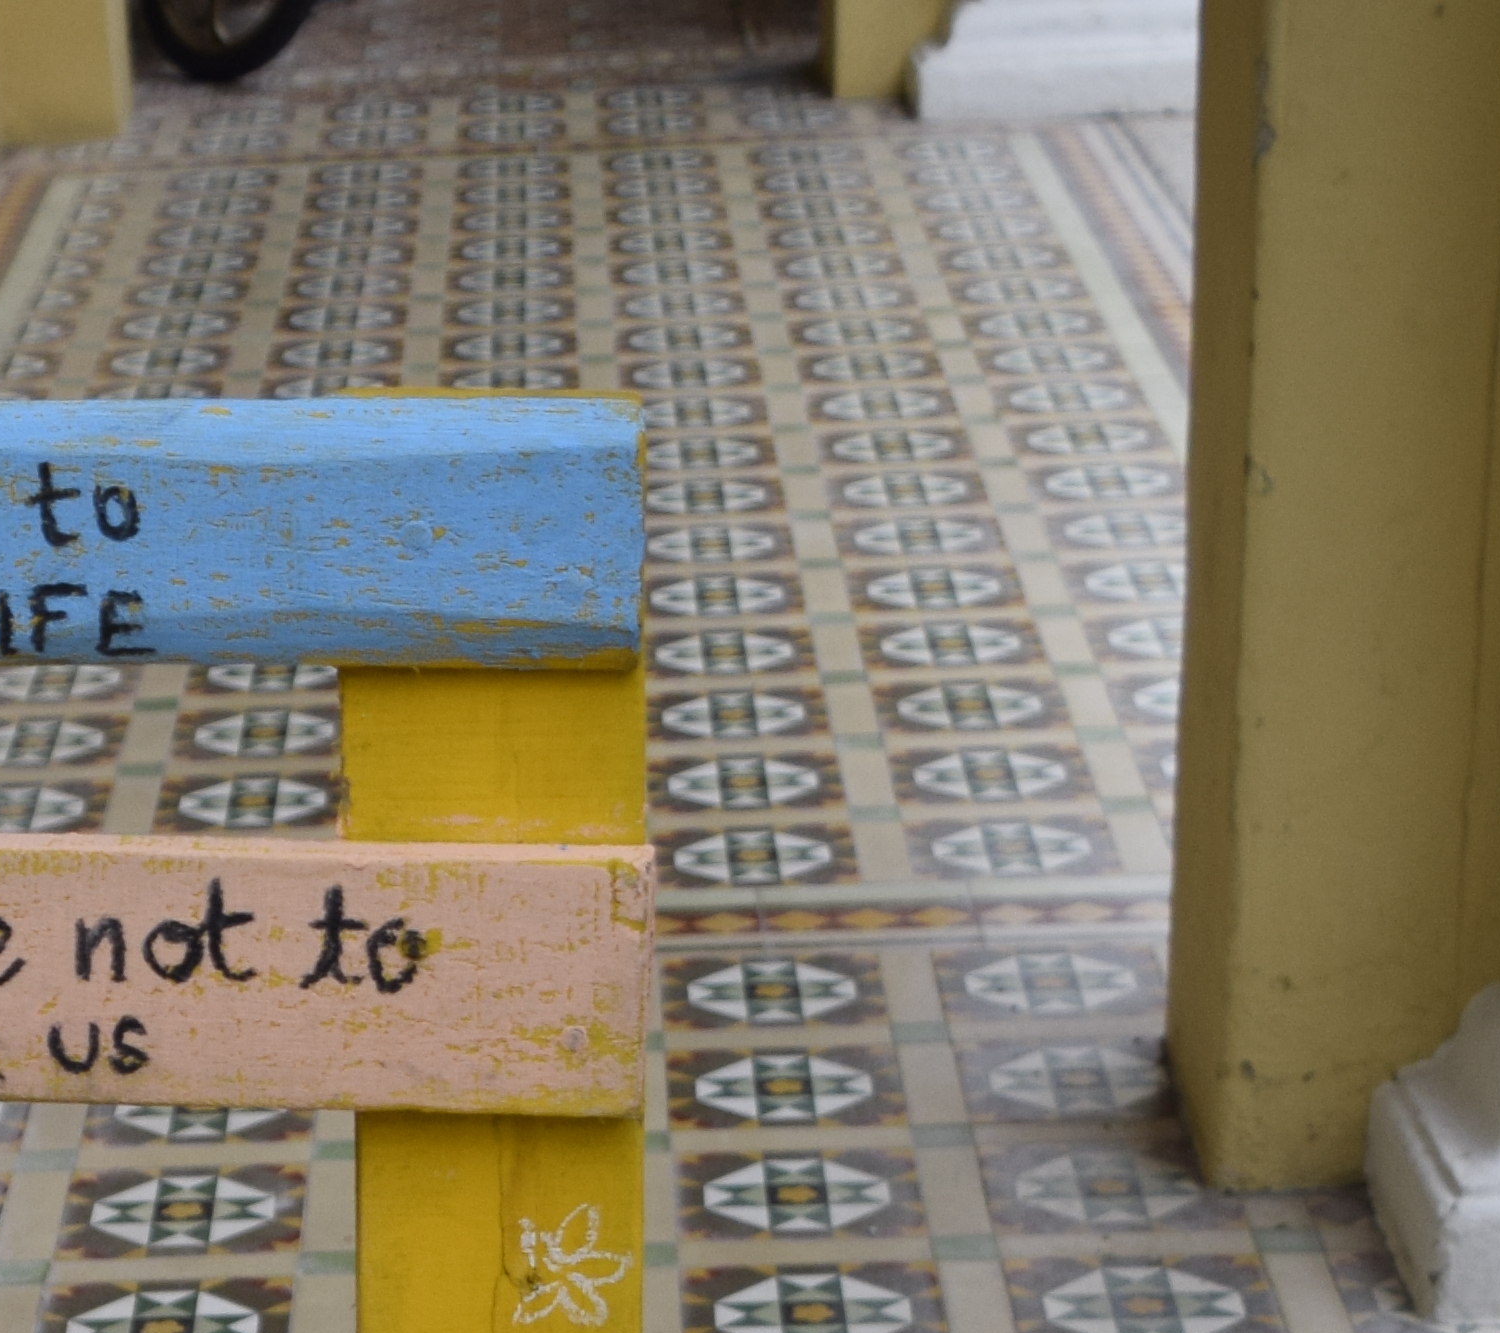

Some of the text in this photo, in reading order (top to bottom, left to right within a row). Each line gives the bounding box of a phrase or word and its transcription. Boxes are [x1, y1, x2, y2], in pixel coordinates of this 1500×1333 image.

[23, 461, 141, 547] to
[74, 877, 257, 983] not
[300, 884, 430, 994] to
[47, 1015, 149, 1074] US
